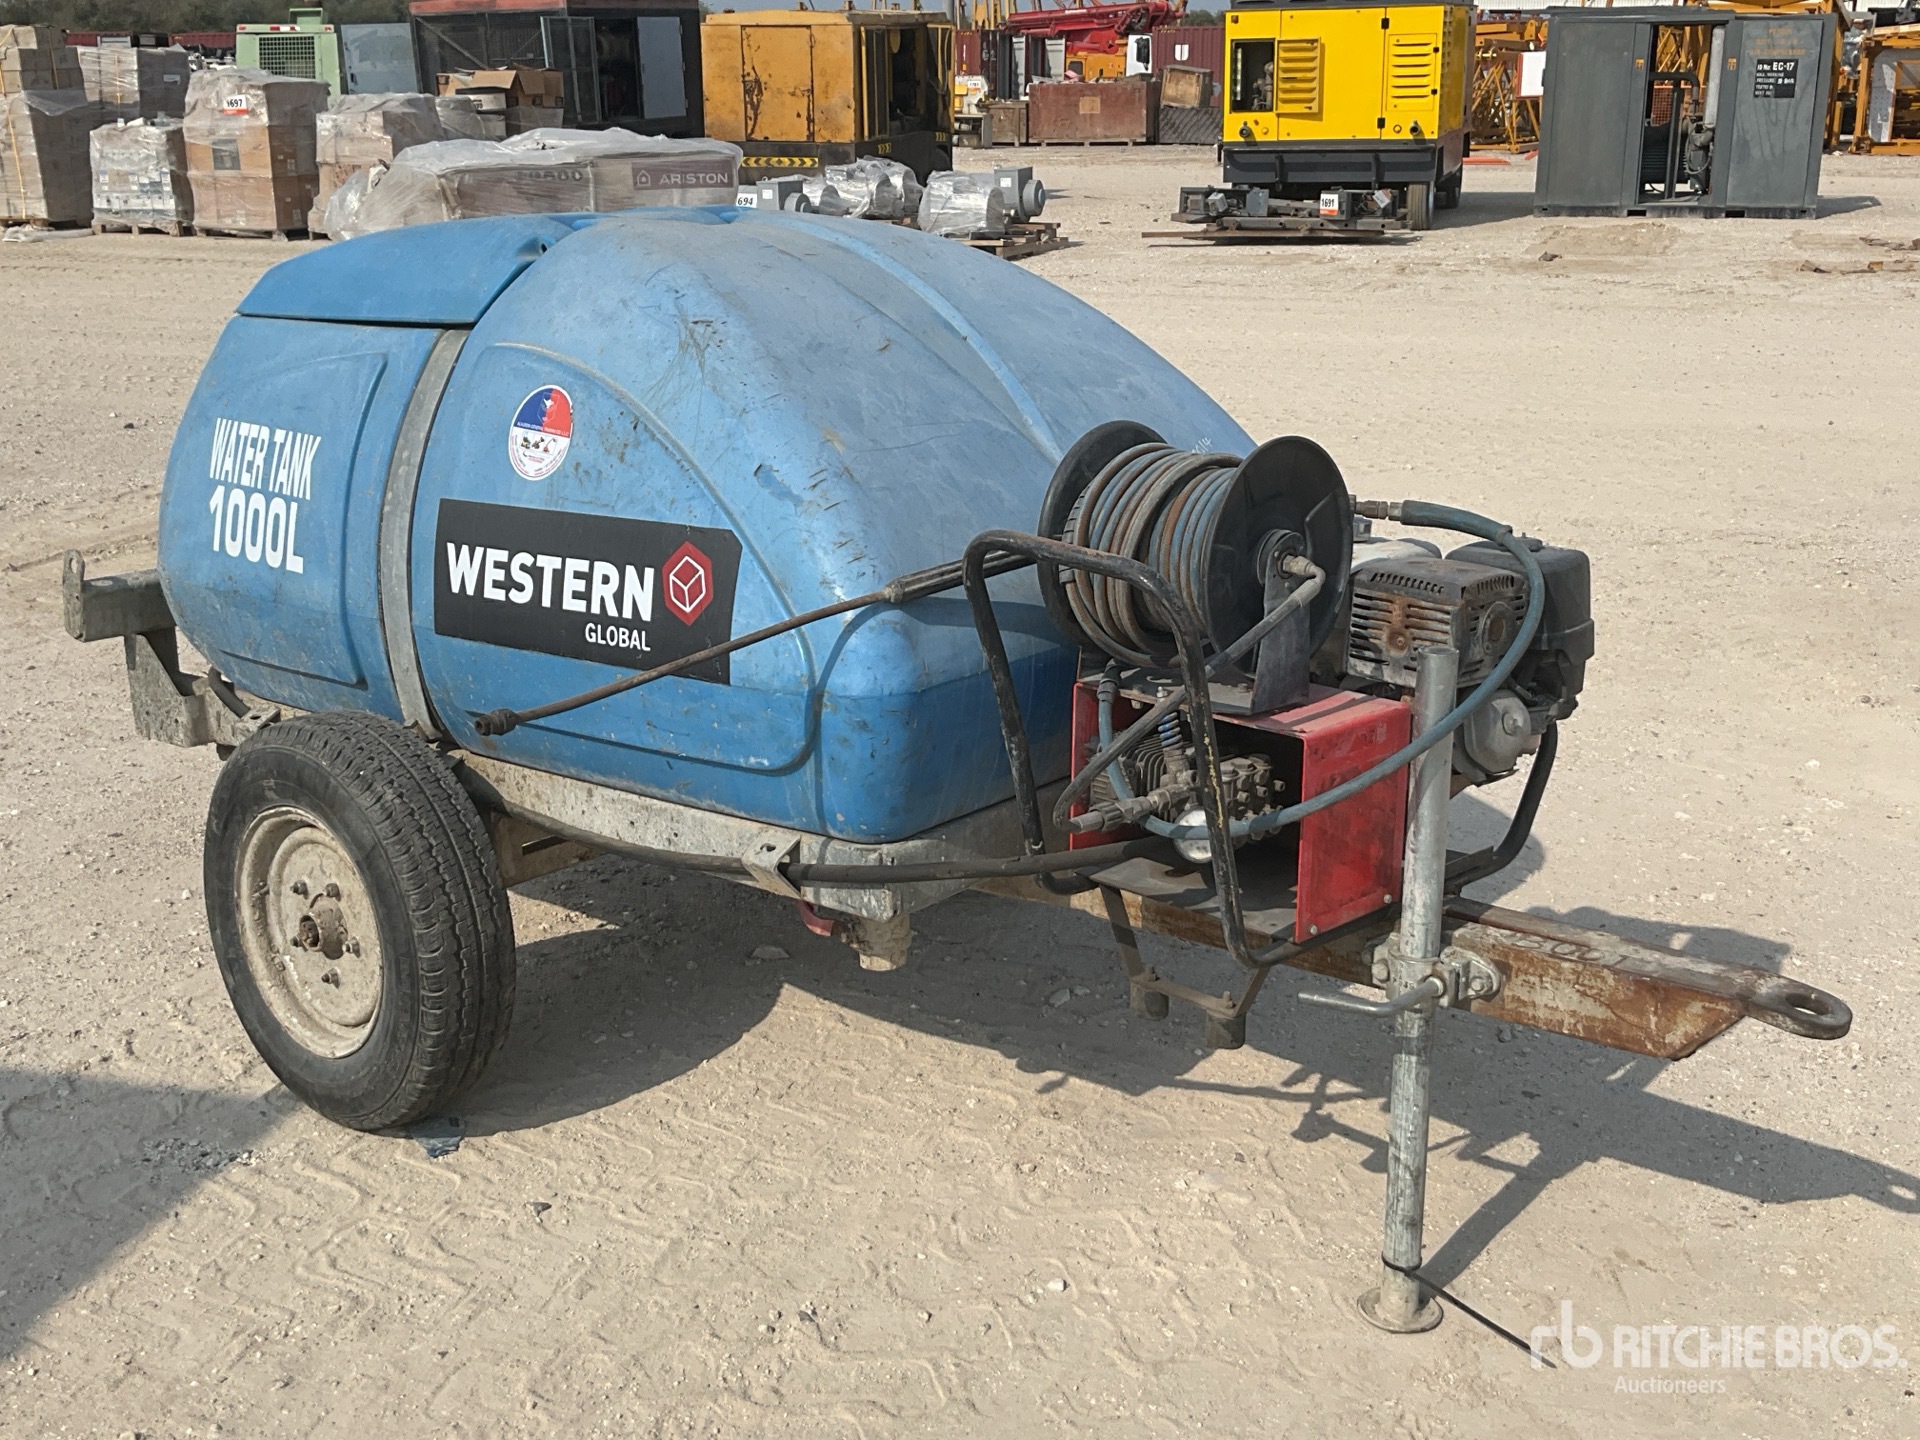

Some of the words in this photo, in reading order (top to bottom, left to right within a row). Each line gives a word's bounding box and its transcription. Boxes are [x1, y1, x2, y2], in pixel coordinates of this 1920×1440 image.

[1772, 62, 1795, 71] EC-17
[226, 99, 243, 107] 1697
[660, 172, 728, 185] ARISTON
[1321, 198, 1335, 207] 1691
[209, 417, 270, 489] WATER
[268, 428, 322, 500] TANK
[209, 484, 304, 574] 1000L
[446, 542, 655, 622] WESTERN
[585, 622, 651, 651] GLOBAL
